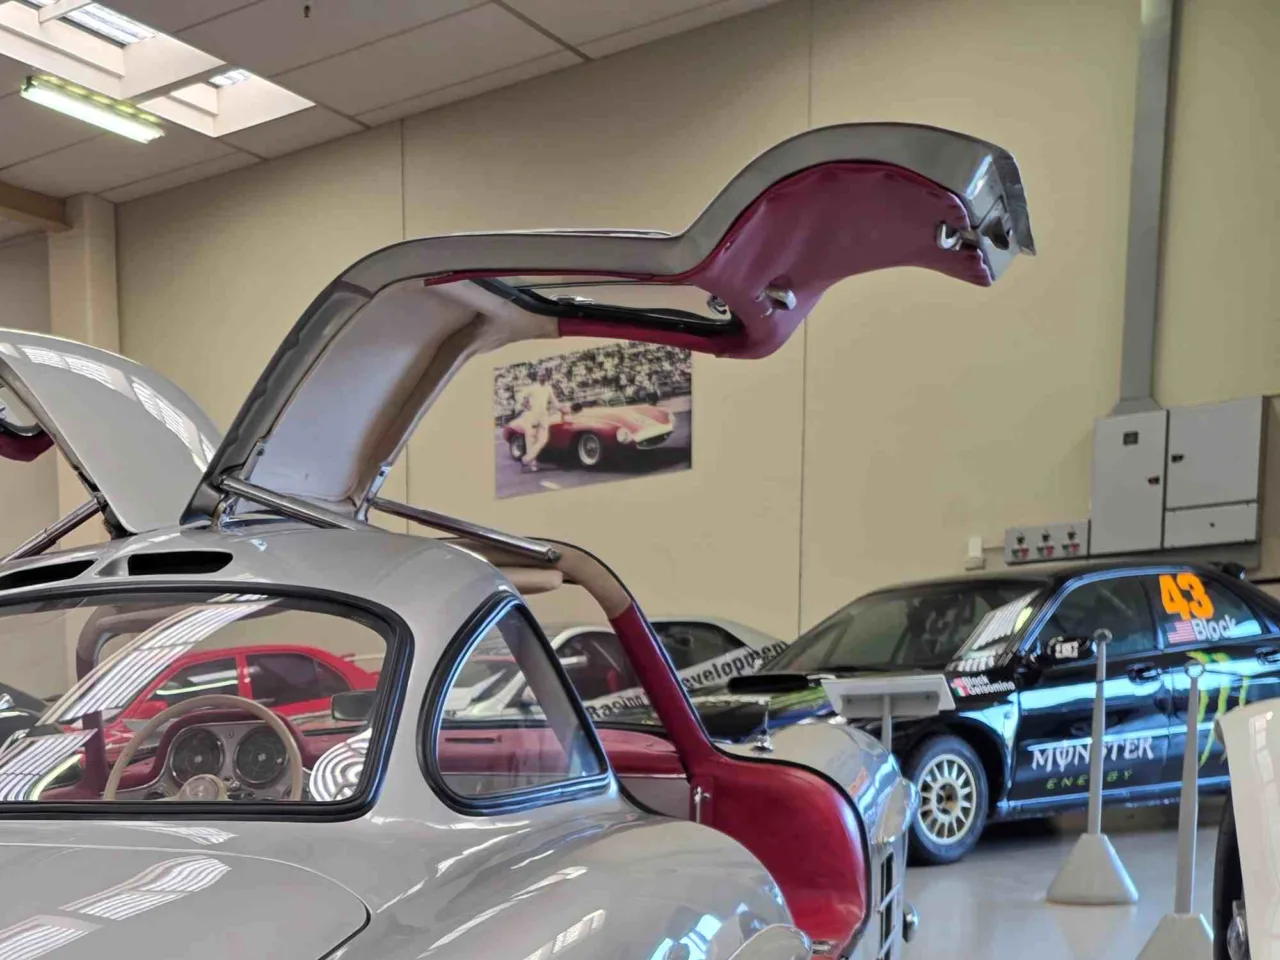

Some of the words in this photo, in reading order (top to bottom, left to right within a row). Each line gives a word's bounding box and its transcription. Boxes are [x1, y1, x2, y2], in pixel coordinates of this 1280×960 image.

[1159, 572, 1215, 621] 43
[1191, 614, 1236, 641] Block
[1046, 769, 1133, 790] ENEGY
